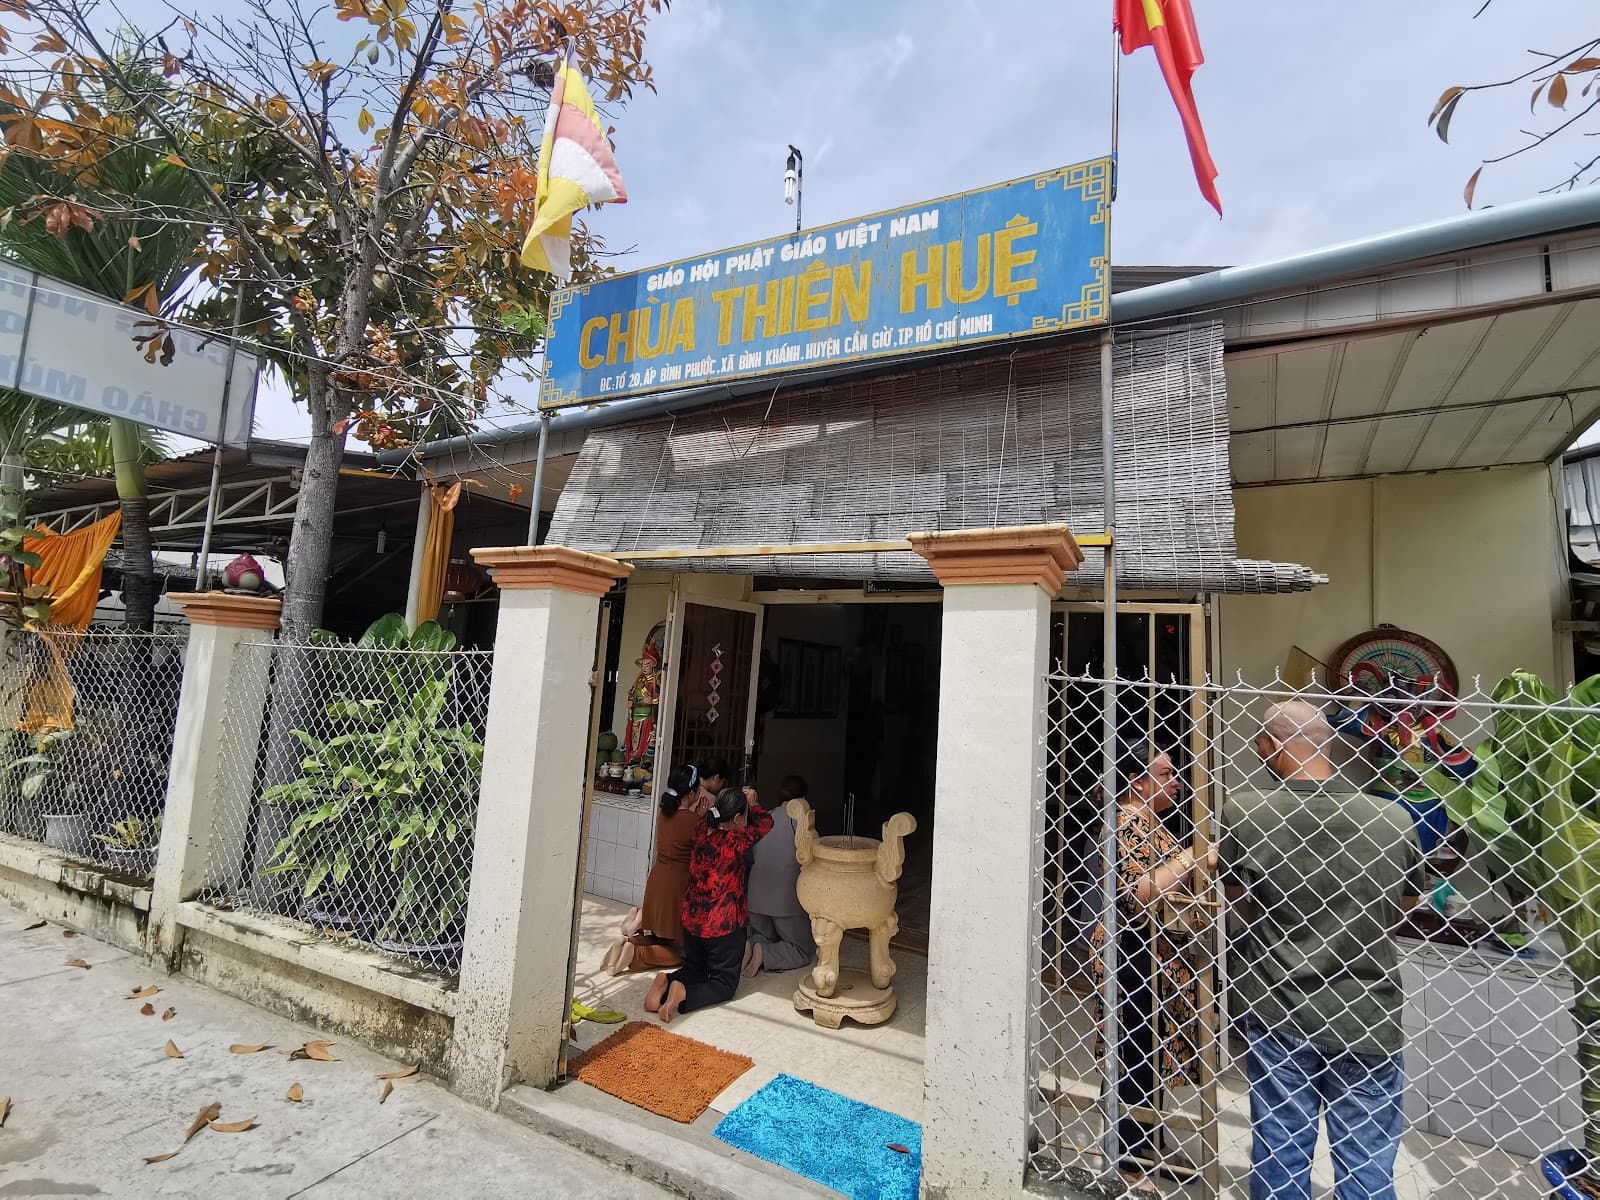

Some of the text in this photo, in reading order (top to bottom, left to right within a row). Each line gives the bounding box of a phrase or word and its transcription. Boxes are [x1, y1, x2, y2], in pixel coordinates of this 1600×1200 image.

[579, 213, 1038, 370] CHÙA THIÊN HUỆ
[646, 209, 939, 292] GIÁO HỘI PHẬT GIÁO VIỆT NAM
[659, 363, 682, 383] BÌNH
[738, 350, 762, 370] BÌNH
[935, 315, 958, 339] CHÍ
[960, 313, 993, 336] MINH
